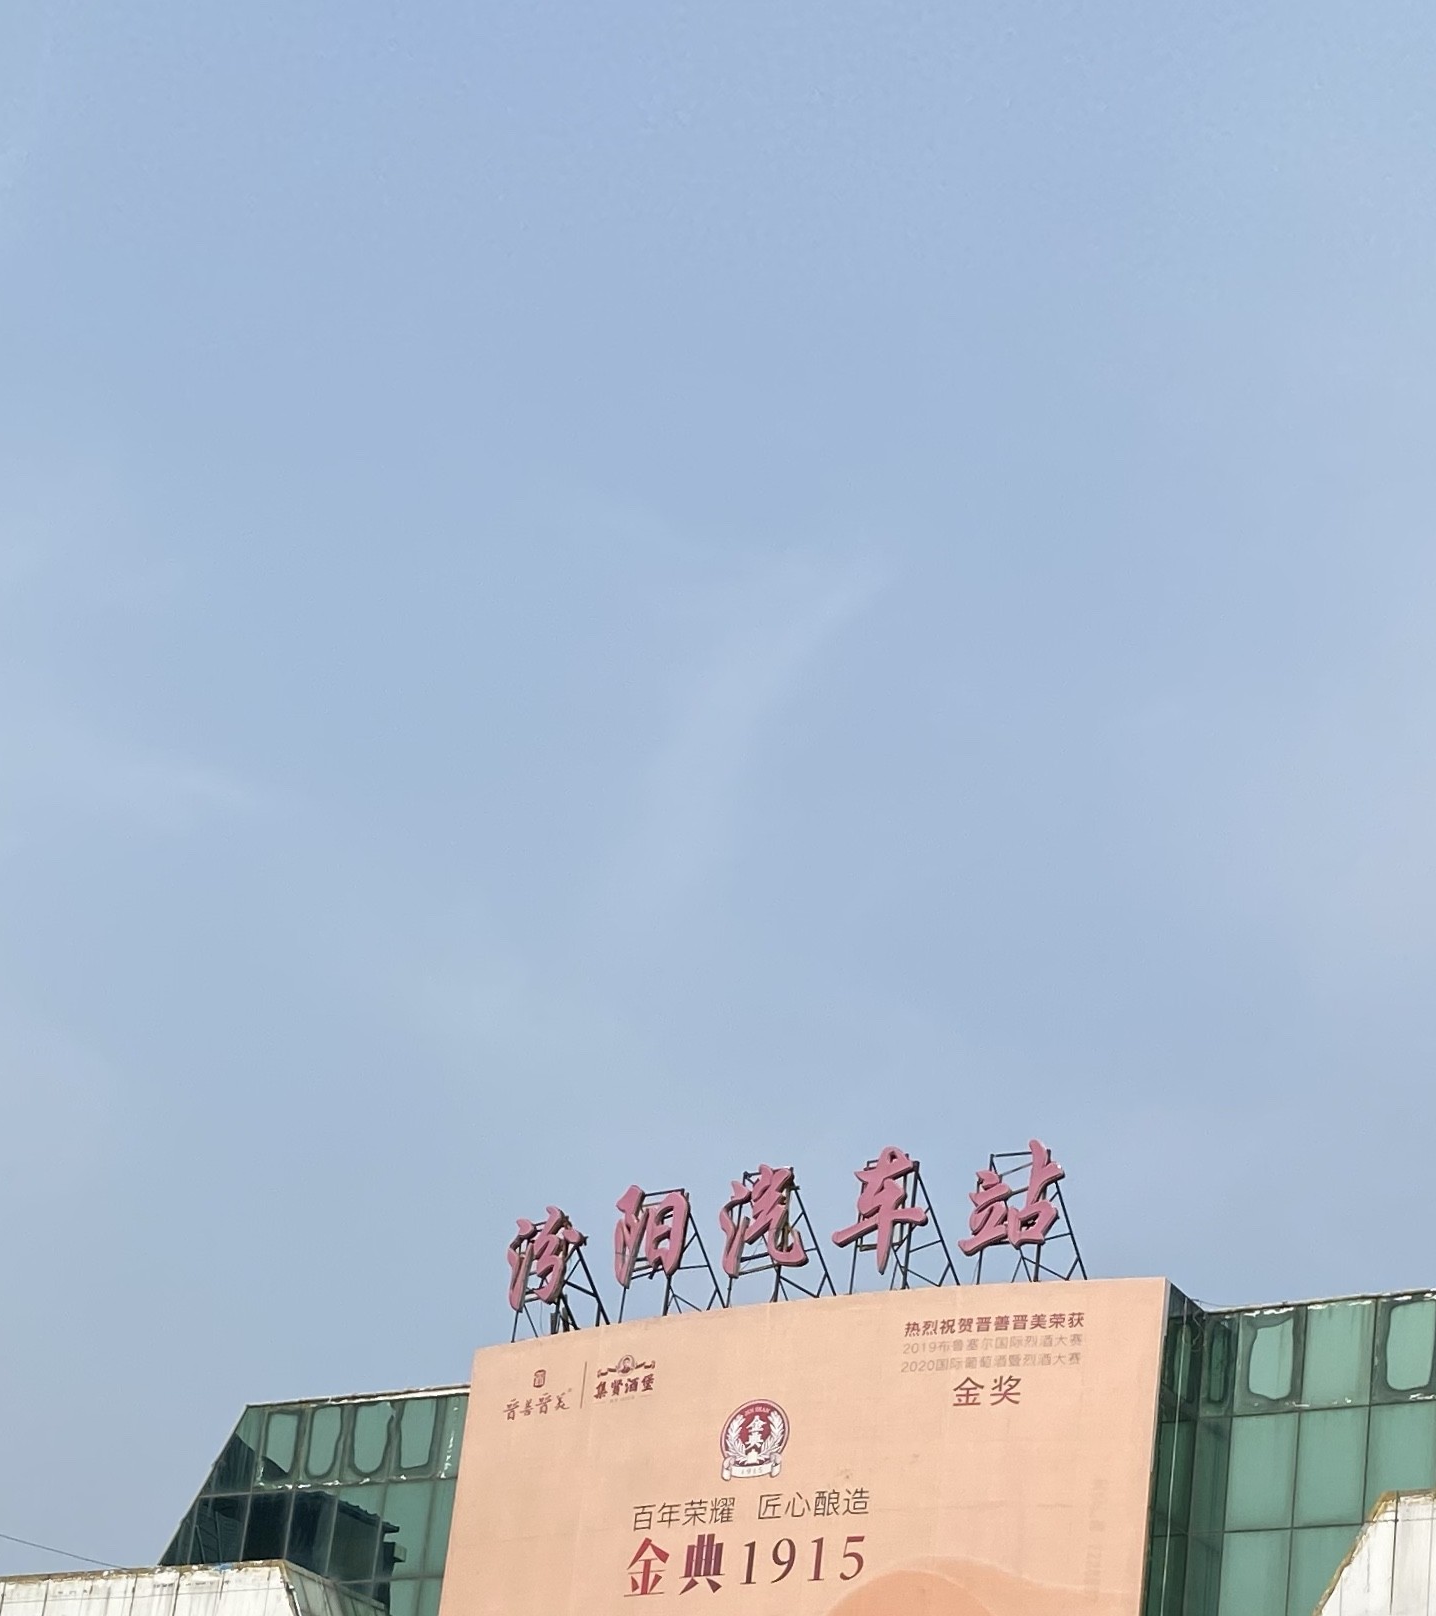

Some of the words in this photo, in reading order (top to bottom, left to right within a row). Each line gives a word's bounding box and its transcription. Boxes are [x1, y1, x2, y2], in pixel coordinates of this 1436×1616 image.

[507, 1140, 1065, 1311] 汾阳汽车站
[904, 1312, 1085, 1337] 热烈祝贺晋善晋美荣获
[593, 1373, 655, 1400] 集贤酒堡
[952, 1374, 1023, 1407] 金奖
[631, 1495, 735, 1531] 百年荣耀
[758, 1488, 870, 1521] 匠心酿造
[623, 1532, 866, 1599] 金典1915
